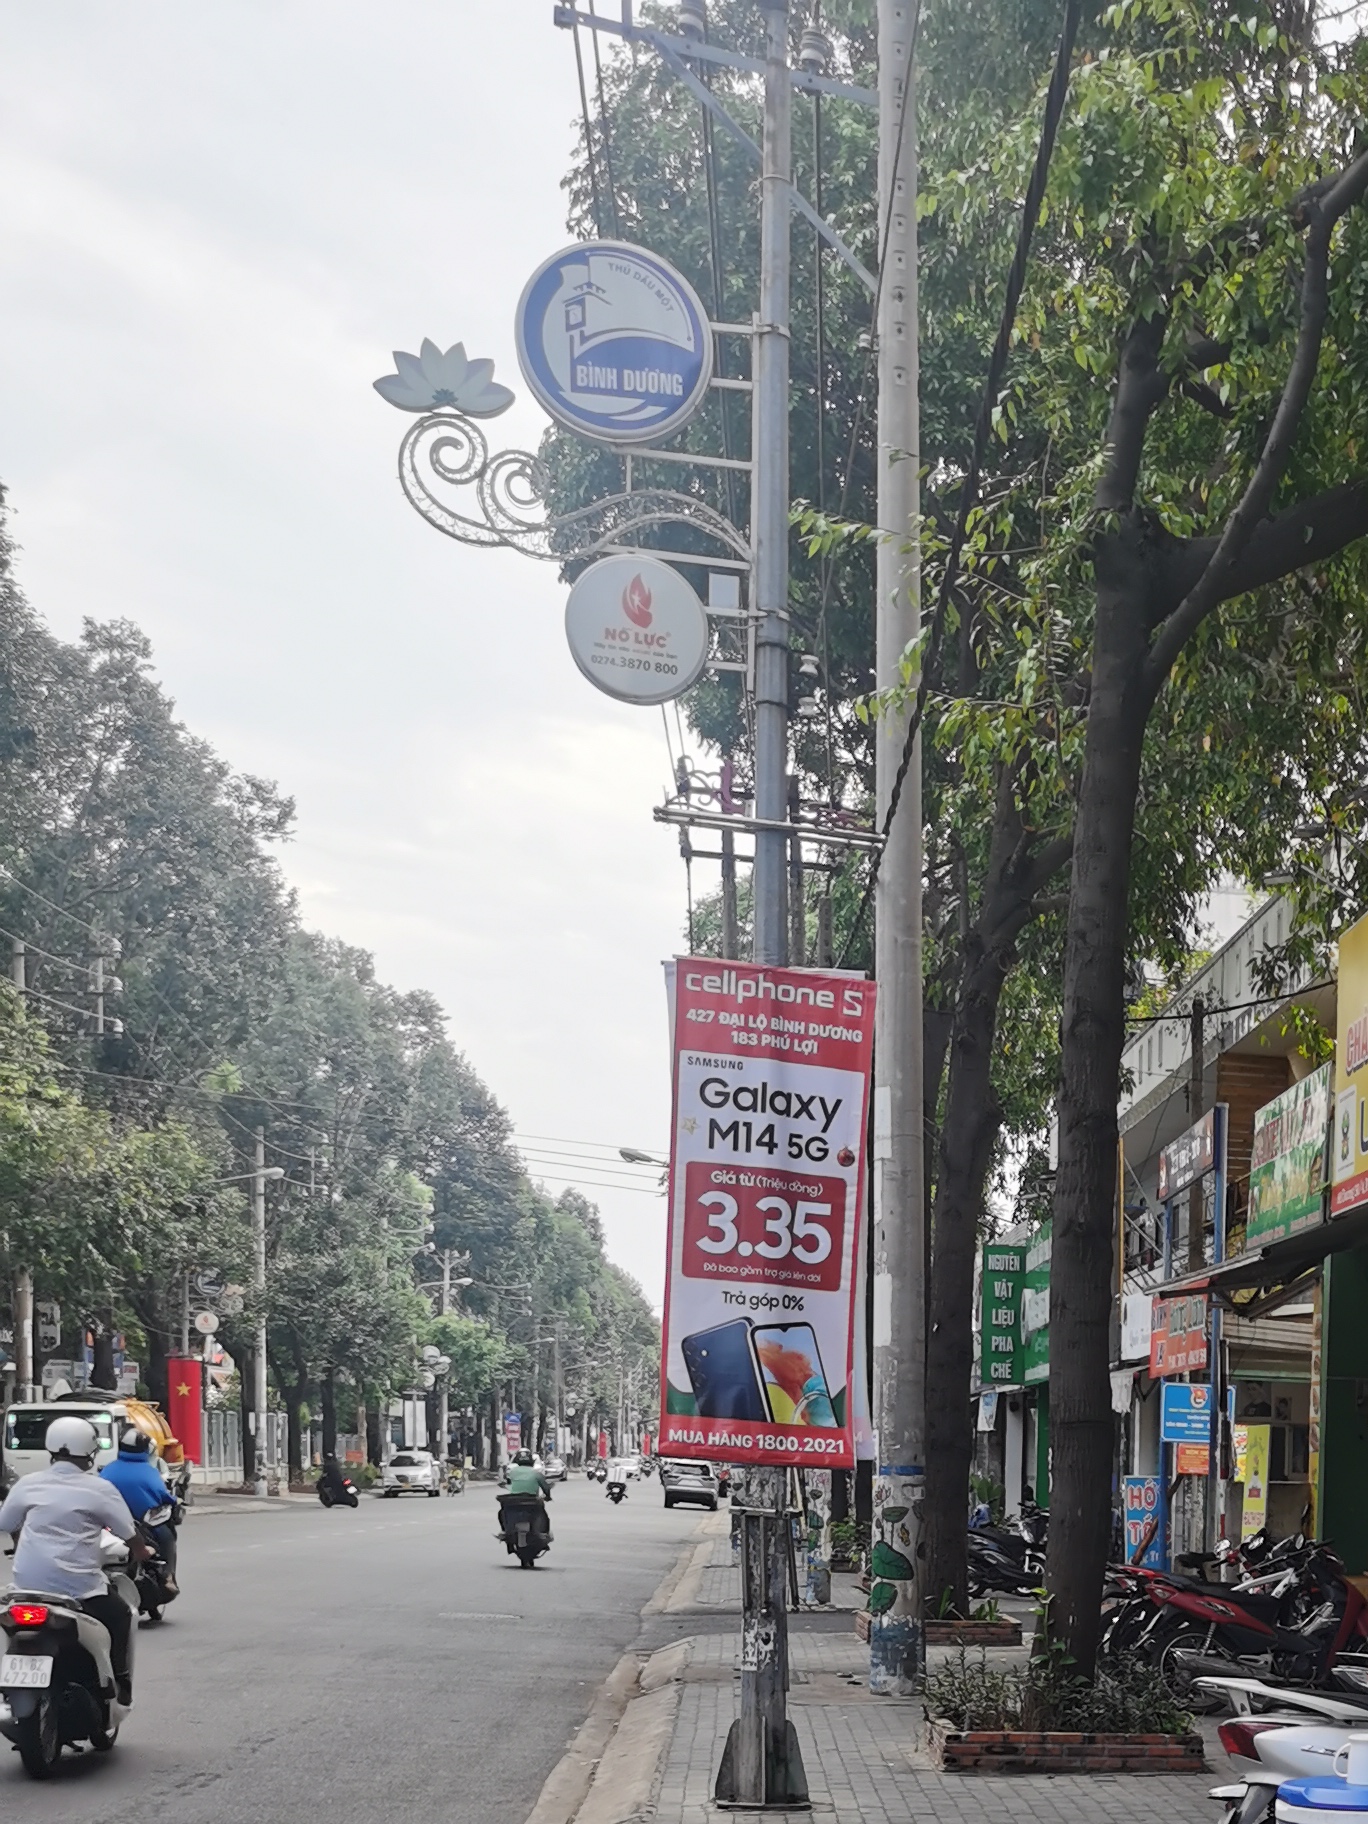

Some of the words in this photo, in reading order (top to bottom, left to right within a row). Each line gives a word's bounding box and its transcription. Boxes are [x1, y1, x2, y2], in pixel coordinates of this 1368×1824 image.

[576, 360, 618, 390] BÌNH
[623, 367, 684, 396] DƯƠNG
[654, 662, 679, 676] 800
[685, 969, 835, 1009] cellphone
[686, 1008, 716, 1023] 427
[718, 1012, 745, 1028] ĐẠI
[748, 1013, 767, 1031] LỘ
[771, 1015, 805, 1034] BÌNH
[809, 1022, 863, 1043] DƯƠNG
[731, 1030, 758, 1046] 183
[761, 1034, 790, 1050] PHÚ
[793, 1039, 818, 1056] LỢI
[687, 1056, 744, 1070] SAMSUNG
[700, 1077, 843, 1133] Galaxy
[708, 1117, 778, 1156] M14
[788, 1133, 830, 1162] 5G
[710, 1169, 736, 1185] Giá
[739, 1172, 755, 1187] từ
[695, 1190, 833, 1265] 3.35
[718, 1264, 738, 1274] bao
[740, 1265, 763, 1277] gồm
[721, 1290, 746, 1306] Trả
[749, 1293, 780, 1312] góp
[782, 1294, 805, 1312] 0%
[994, 1278, 1014, 1301] VẬT
[991, 1306, 1015, 1329] LIỆU
[991, 1335, 1014, 1353] PHA
[990, 1359, 1013, 1379] CHẾ
[668, 1428, 704, 1445] MUA
[708, 1430, 753, 1448] HÀNG
[755, 1434, 845, 1455] 1800.2021
